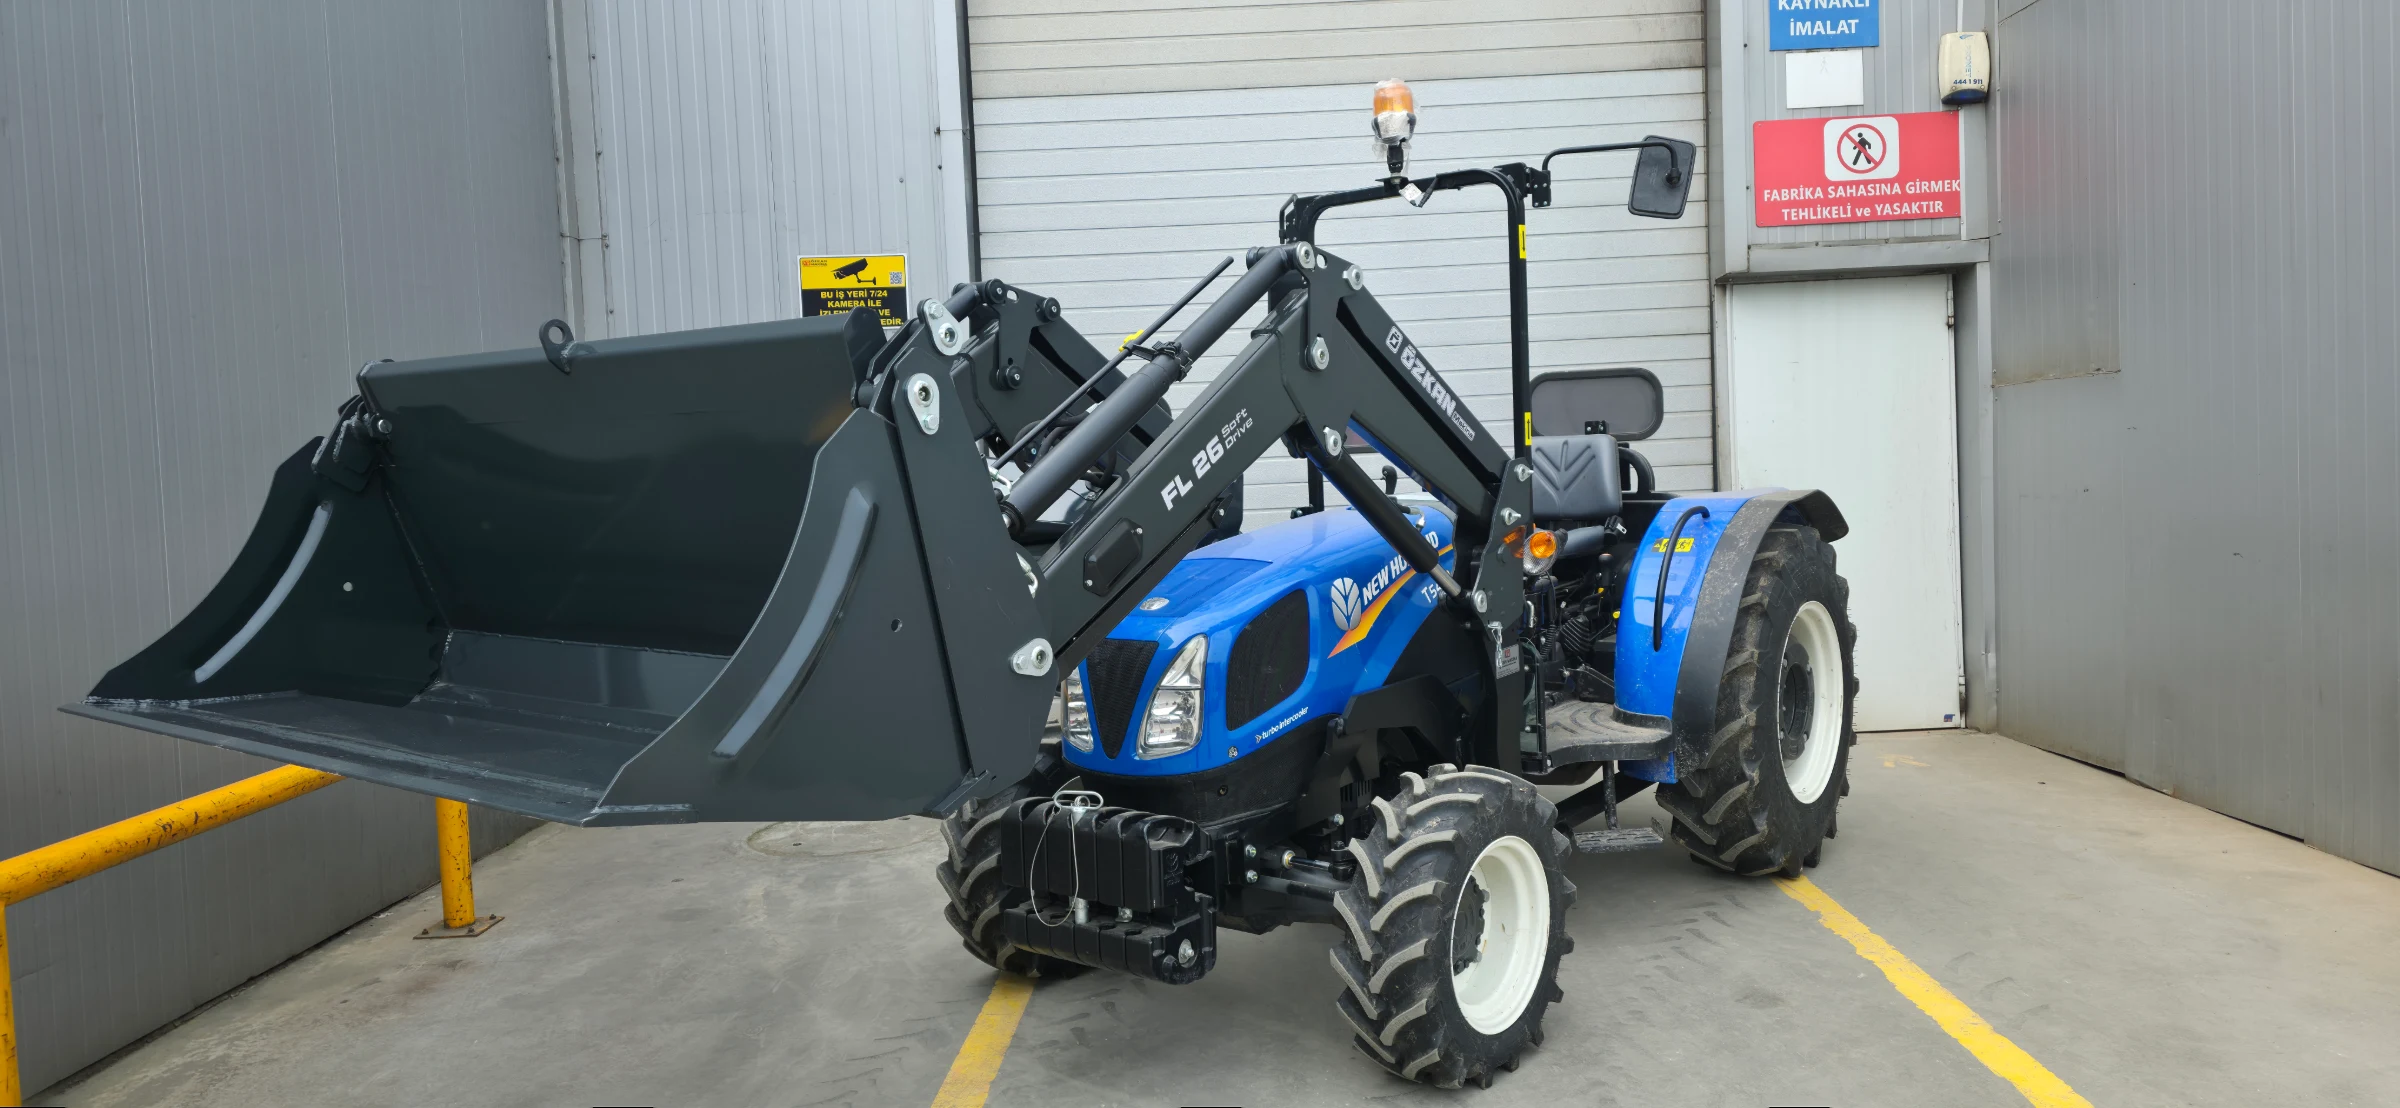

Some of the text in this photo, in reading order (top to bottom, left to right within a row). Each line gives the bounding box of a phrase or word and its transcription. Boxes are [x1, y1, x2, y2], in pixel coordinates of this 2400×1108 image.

[1790, 18, 1859, 36] İMALAT
[1764, 178, 1961, 202] FABRİKA SAHASINA GİRMEK
[1782, 200, 1944, 221] TEHLİKELİ ve YASAKTIR
[820, 291, 833, 299] BU
[835, 290, 845, 300] İŞ
[846, 290, 868, 298] YERİ
[827, 299, 882, 308] KAMERA İLE
[879, 308, 891, 316] VE
[1401, 344, 1457, 418] ÖZKAN
[1221, 408, 1248, 438] Soft
[1224, 417, 1253, 450] Drive
[1160, 434, 1225, 511] FL 26
[1362, 564, 1389, 606] NEW
[1262, 706, 1309, 740] turbo intercooler
